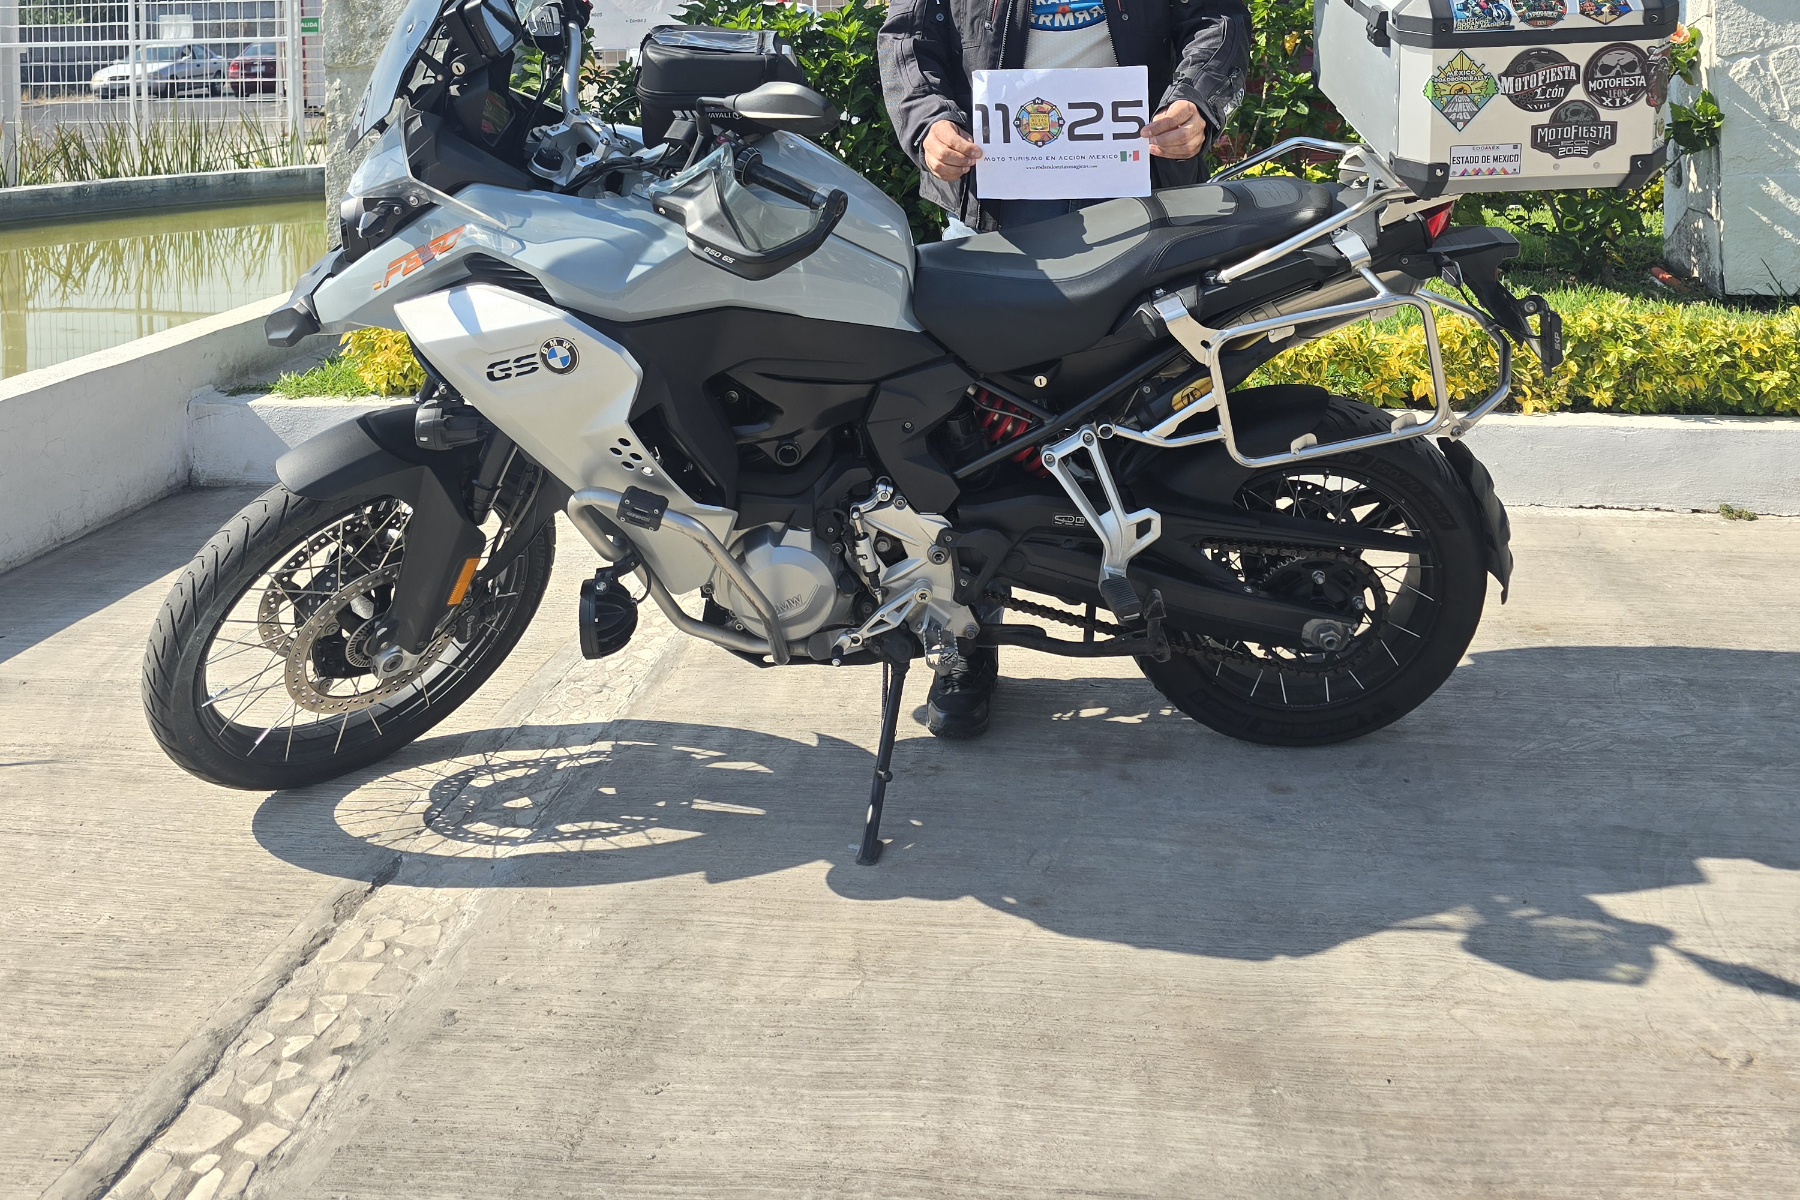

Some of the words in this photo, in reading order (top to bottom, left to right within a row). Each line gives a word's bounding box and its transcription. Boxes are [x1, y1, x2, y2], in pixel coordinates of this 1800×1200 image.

[1500, 65, 1577, 95] MOTOFIESTA
[1588, 75, 1647, 92] MOTOFIESTA
[1600, 93, 1635, 107] XIX
[1068, 100, 1146, 141] 25
[1537, 124, 1612, 143] MOTOFIESTA
[1452, 155, 1480, 165] ESTADO
[1481, 155, 1491, 164] DE
[1558, 146, 1589, 157] 2025
[703, 246, 722, 259] 850
[721, 254, 736, 265] GS
[486, 352, 541, 383] GS
